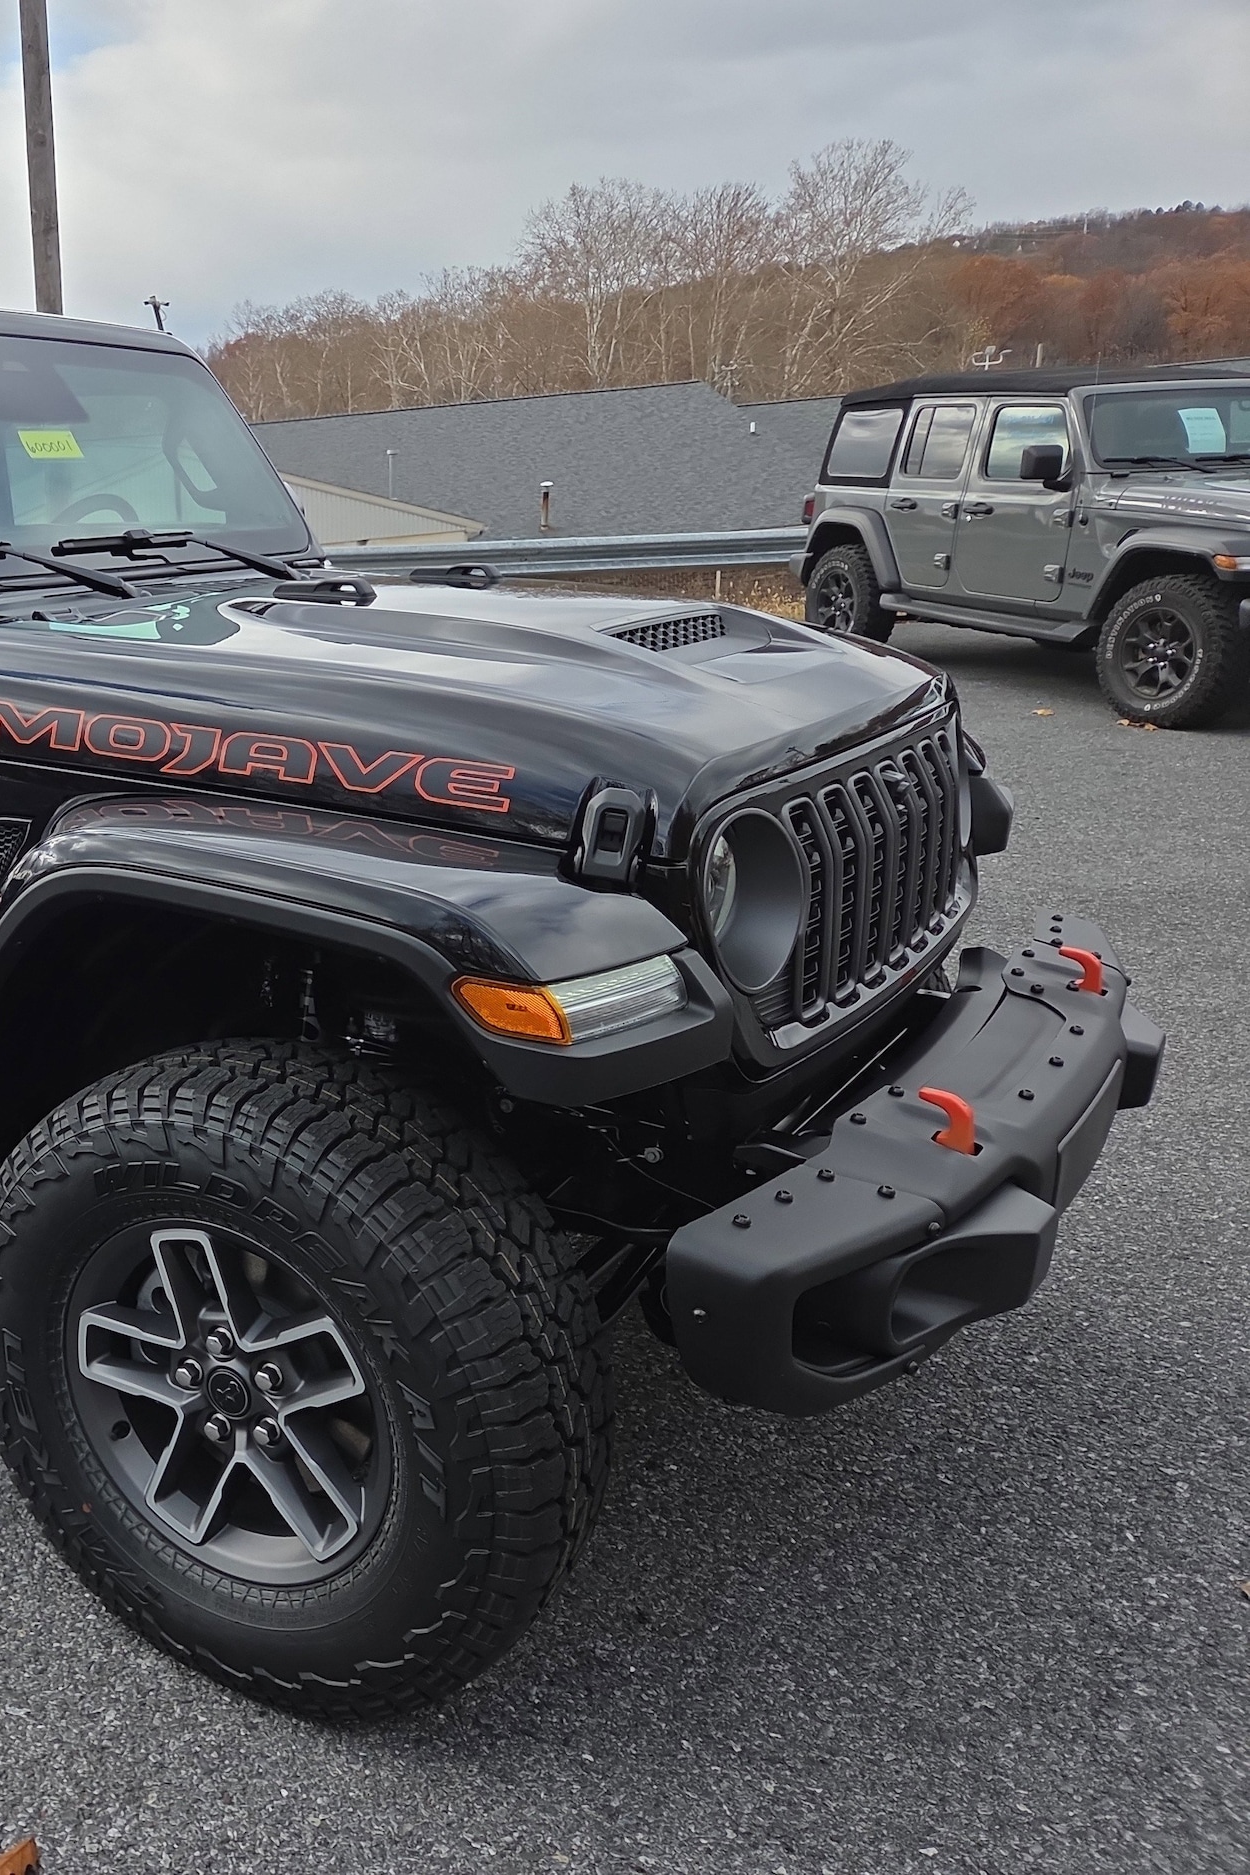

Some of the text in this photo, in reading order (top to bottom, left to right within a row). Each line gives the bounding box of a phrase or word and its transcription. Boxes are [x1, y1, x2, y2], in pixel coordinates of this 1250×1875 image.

[25, 440, 73, 454] 600001
[1068, 568, 1095, 583] Jeep
[93, 1160, 410, 1364] WILDPEAK
